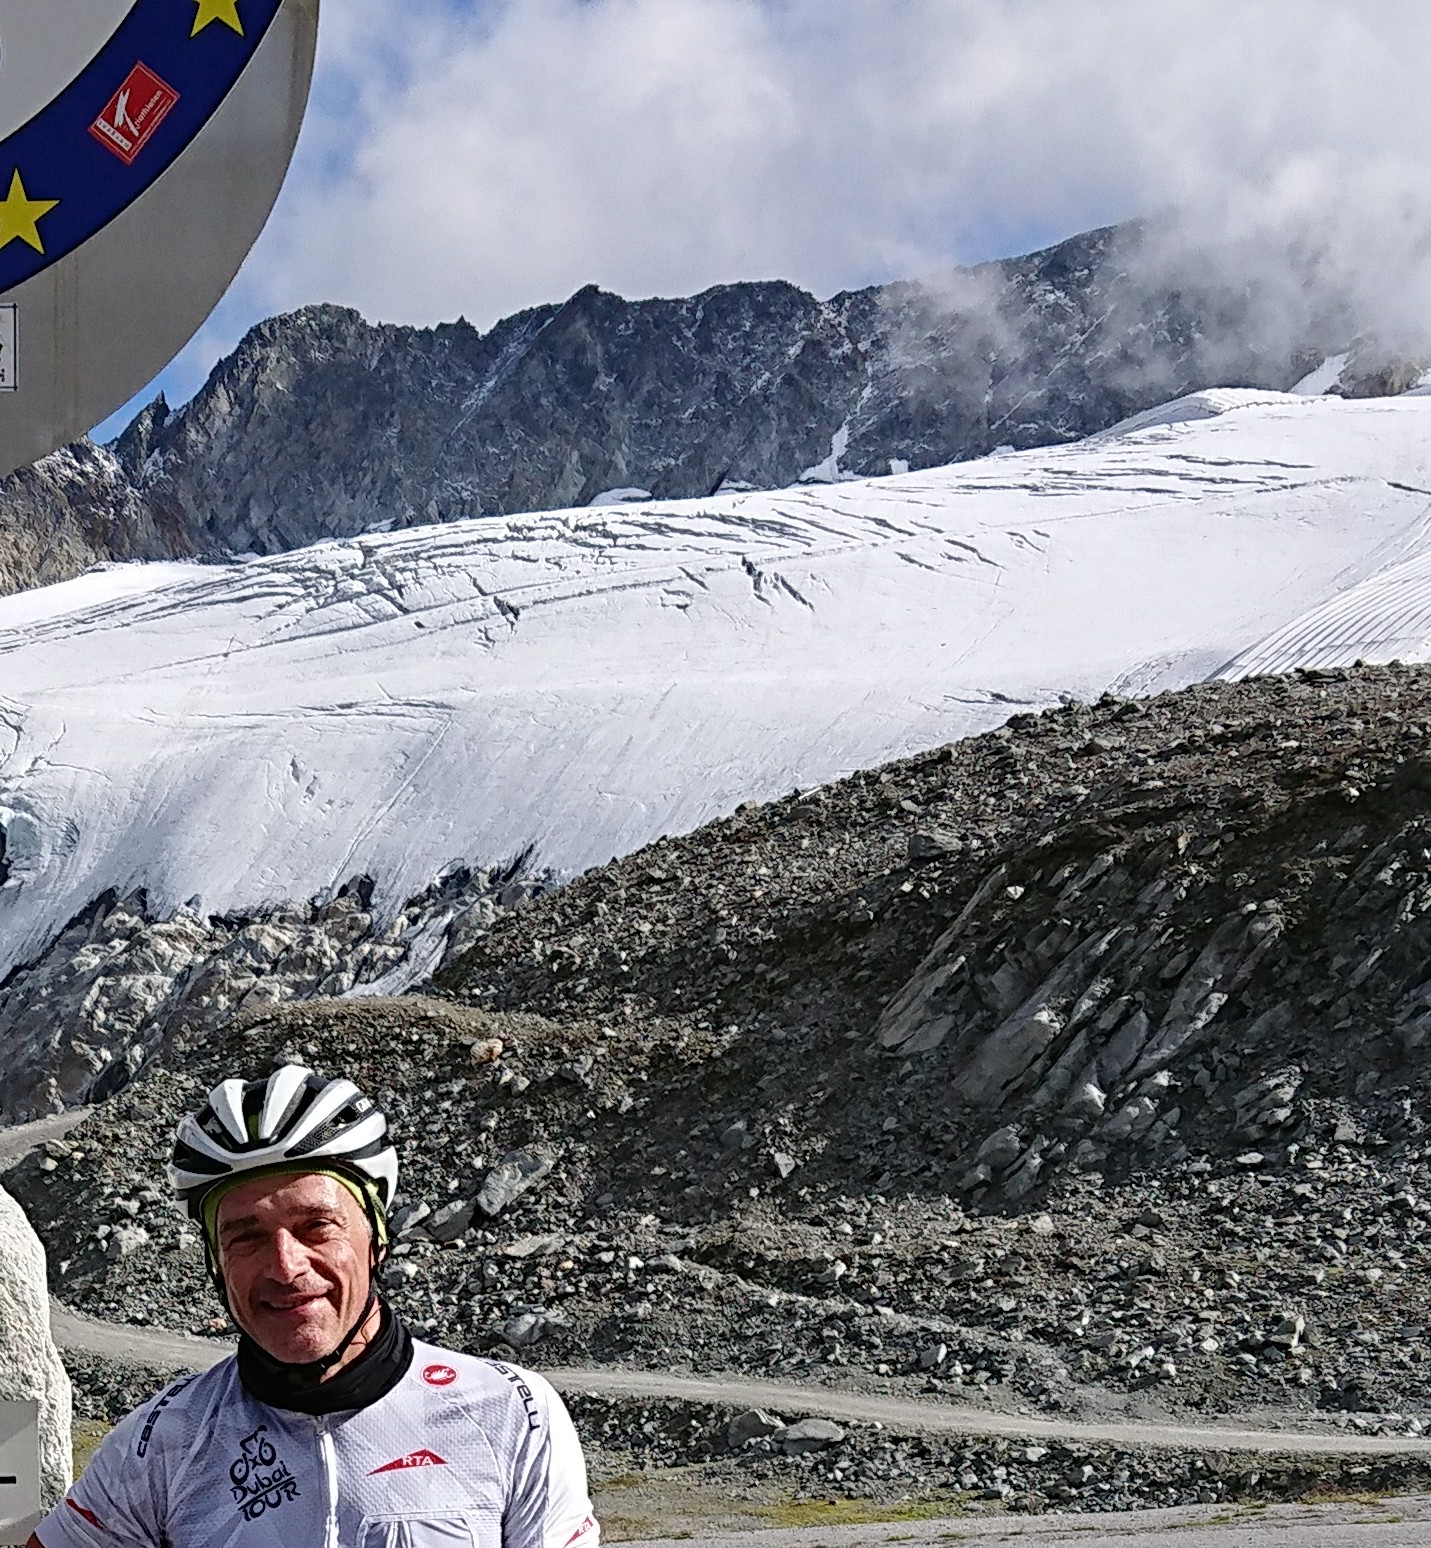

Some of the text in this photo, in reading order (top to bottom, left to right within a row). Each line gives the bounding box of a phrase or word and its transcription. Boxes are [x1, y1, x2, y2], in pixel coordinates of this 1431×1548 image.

[229, 1460, 292, 1501] Dubai
[402, 1455, 434, 1467] RTA
[238, 1481, 302, 1522] TOUR
